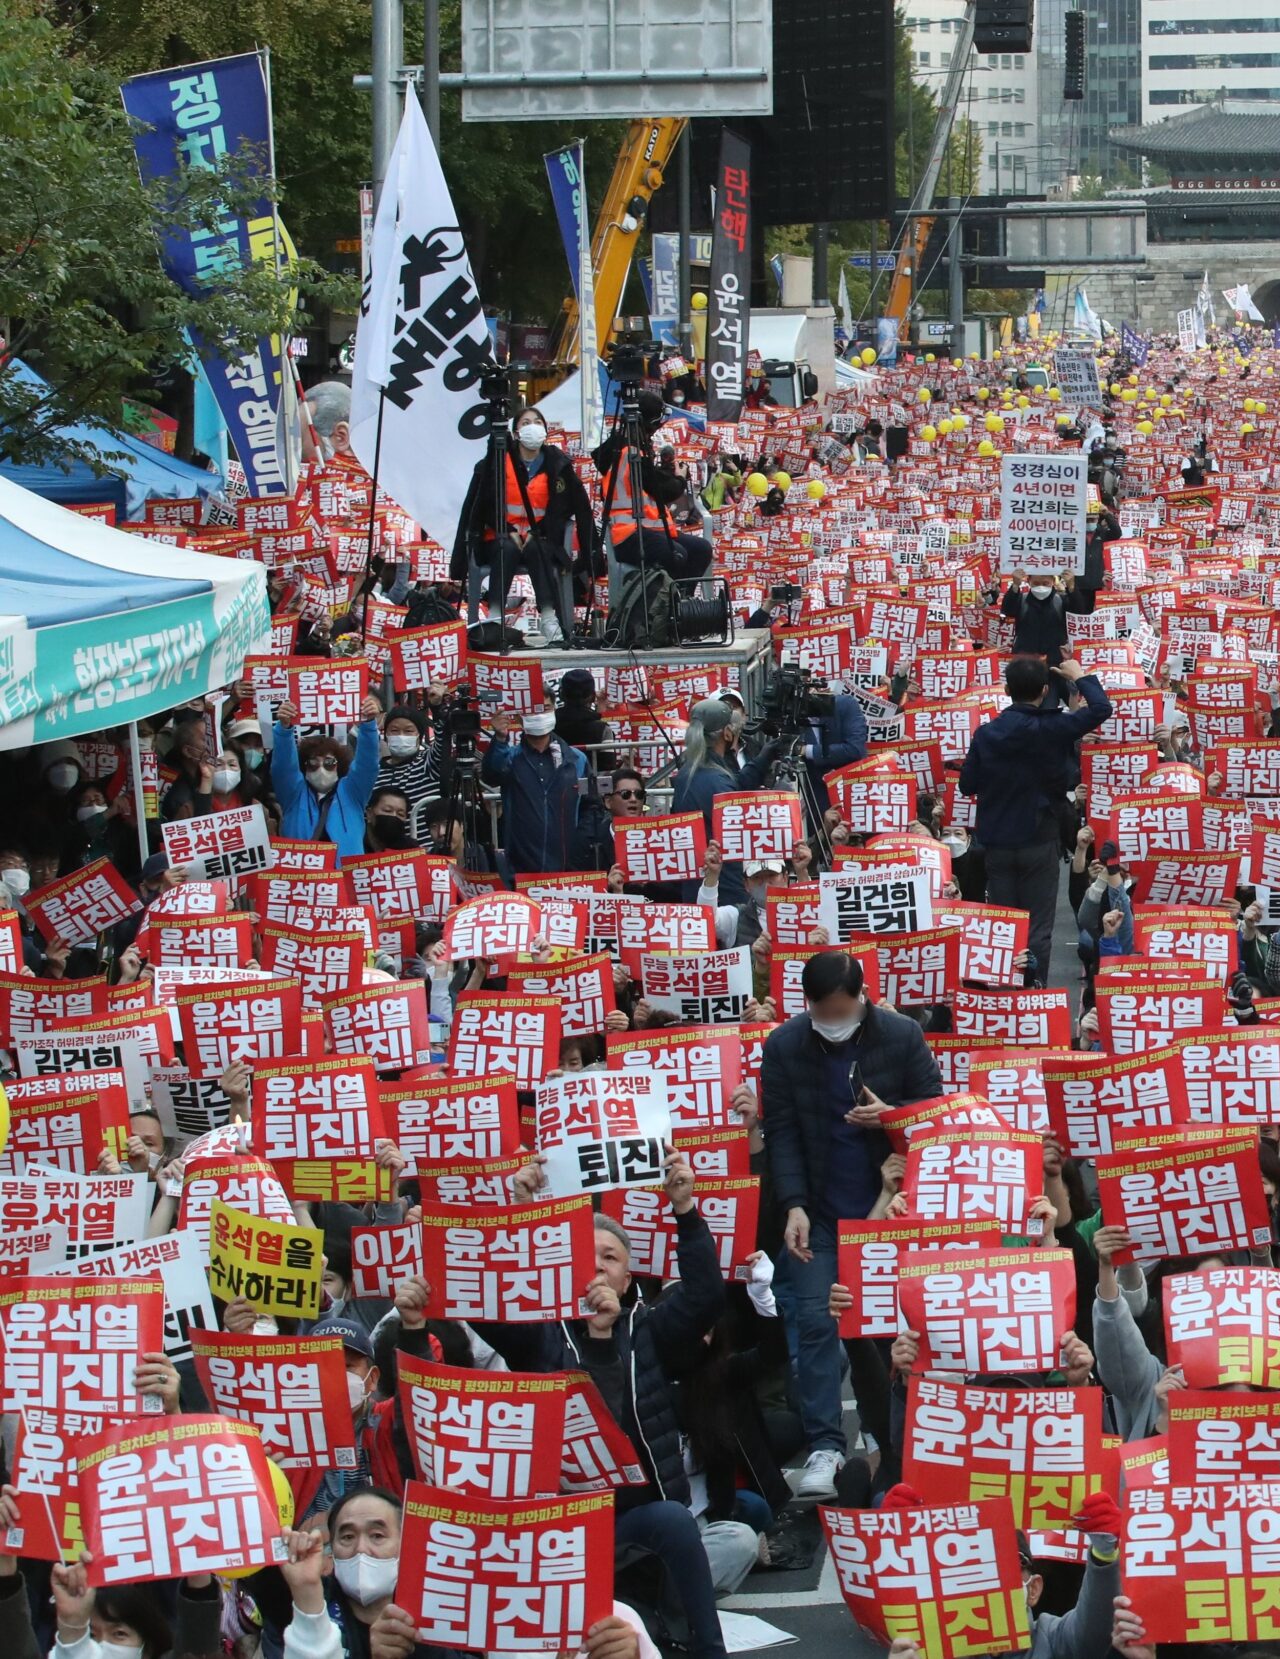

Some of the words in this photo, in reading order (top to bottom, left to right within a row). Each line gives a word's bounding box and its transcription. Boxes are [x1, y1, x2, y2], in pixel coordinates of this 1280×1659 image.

[645, 128, 658, 161] KATO
[720, 166, 749, 252] 탄핵
[711, 272, 744, 401] 윤석열
[1011, 464, 1079, 480] 정경심이
[1013, 482, 1075, 497] 4년이면
[1008, 519, 1078, 533] 400년이다.
[1010, 500, 1079, 515] 김건희는
[1008, 555, 1078, 569] 구속하라!
[1009, 537, 1078, 551] 김건희를
[871, 602, 920, 621] 윤석열
[401, 633, 459, 662] 윤석열
[298, 670, 360, 693] 윤석열
[301, 695, 361, 724] 퇴진!
[164, 823, 186, 837] 무능
[190, 819, 215, 832] 무지
[218, 810, 253, 828] 거짓말
[836, 886, 916, 910] 김건희
[458, 1009, 544, 1046] 윤석열
[5, 1078, 60, 1101] 주가조작
[65, 1071, 124, 1091] 허위경력
[538, 1086, 559, 1105] 무능
[563, 1080, 597, 1098] 무지
[603, 1075, 652, 1095] 거짓말
[397, 1093, 500, 1133] 윤석열
[538, 1098, 638, 1148] 윤석열
[293, 1160, 390, 1201] 특검!
[918, 1145, 1025, 1184] 윤석열
[1, 1181, 37, 1200] 무능
[44, 1181, 80, 1200] 무지
[86, 1179, 135, 1199] 거짓말
[1119, 1162, 1242, 1214] 윤석열
[214, 1212, 315, 1270] 윤석열을
[443, 1222, 571, 1267] 윤석열
[211, 1253, 318, 1309] 수사하라!
[444, 1266, 574, 1322] 퇴진!
[922, 1271, 1053, 1317] 윤석열
[1170, 1274, 1204, 1294] 무능
[1209, 1269, 1244, 1289] 무지
[5, 1304, 138, 1352] 윤석열
[926, 1314, 1054, 1372] 퇴진!
[209, 1357, 323, 1409] 윤석열
[917, 1381, 958, 1408] 무능
[964, 1389, 1007, 1412] 무지
[1014, 1391, 1076, 1414] 거짓말
[411, 1385, 535, 1450] 윤석열
[1170, 1407, 1217, 1421] 민생파탄
[1220, 1403, 1269, 1419] 정치보복
[912, 1405, 1085, 1472] 윤석열
[96, 1444, 258, 1510] 윤석열
[406, 1501, 452, 1522] 민생파탄
[455, 1510, 508, 1525] 정치보복
[511, 1509, 563, 1526] 평화파괴
[566, 1494, 615, 1516] 친일매국
[1129, 1488, 1165, 1513] 무능
[1171, 1487, 1216, 1511] 무지
[101, 1496, 266, 1583] 퇴진!
[824, 1510, 855, 1535] 무능
[859, 1512, 902, 1537] 무지
[909, 1505, 980, 1534] 거짓말
[425, 1521, 586, 1582] 윤석열
[830, 1528, 1002, 1599] 윤석열
[420, 1577, 586, 1649] 퇴진!
